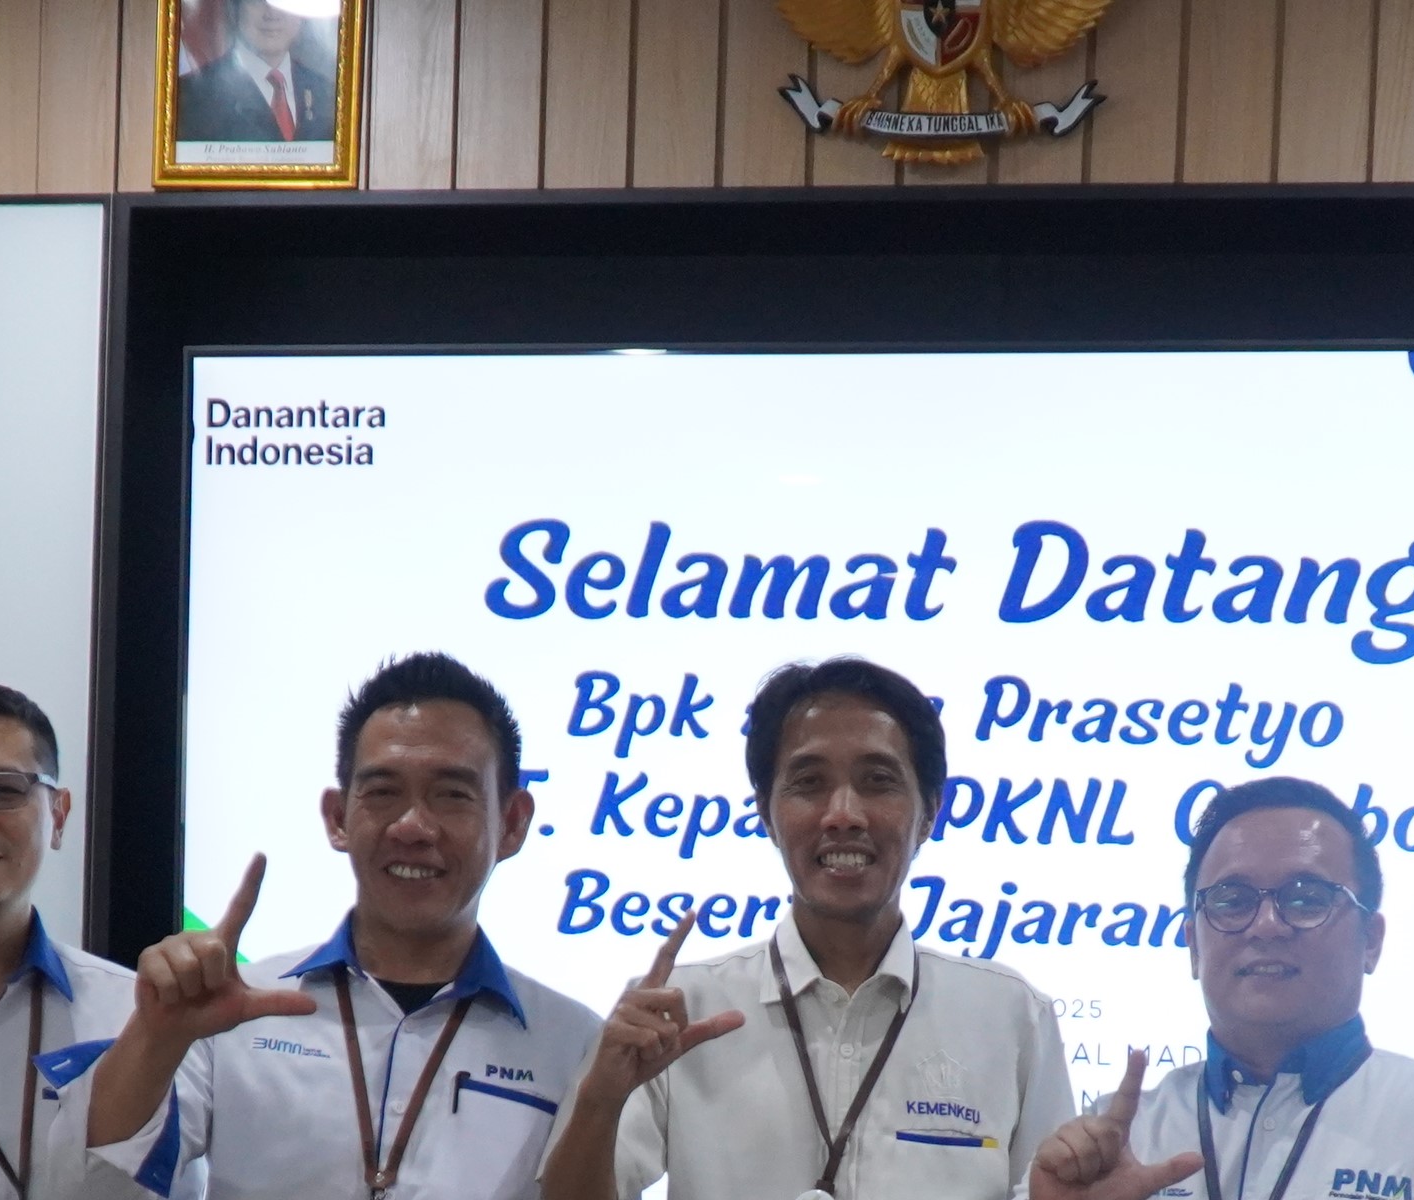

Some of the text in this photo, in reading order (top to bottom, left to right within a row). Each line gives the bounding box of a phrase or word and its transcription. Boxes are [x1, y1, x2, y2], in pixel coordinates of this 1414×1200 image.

[927, 116, 982, 132] TUNGGAL
[206, 398, 386, 428] Danantara
[205, 435, 374, 466] Indonesia
[484, 518, 958, 621] Selamat
[567, 670, 714, 759] Bpk
[975, 674, 1345, 769] Prasetyo
[590, 770, 775, 860] Kepa
[929, 775, 1135, 845] PKNL
[557, 868, 792, 939] Beser
[1053, 998, 1103, 1019] 025
[485, 1064, 535, 1082] PNM
[906, 1100, 980, 1125] KEMENKEU
